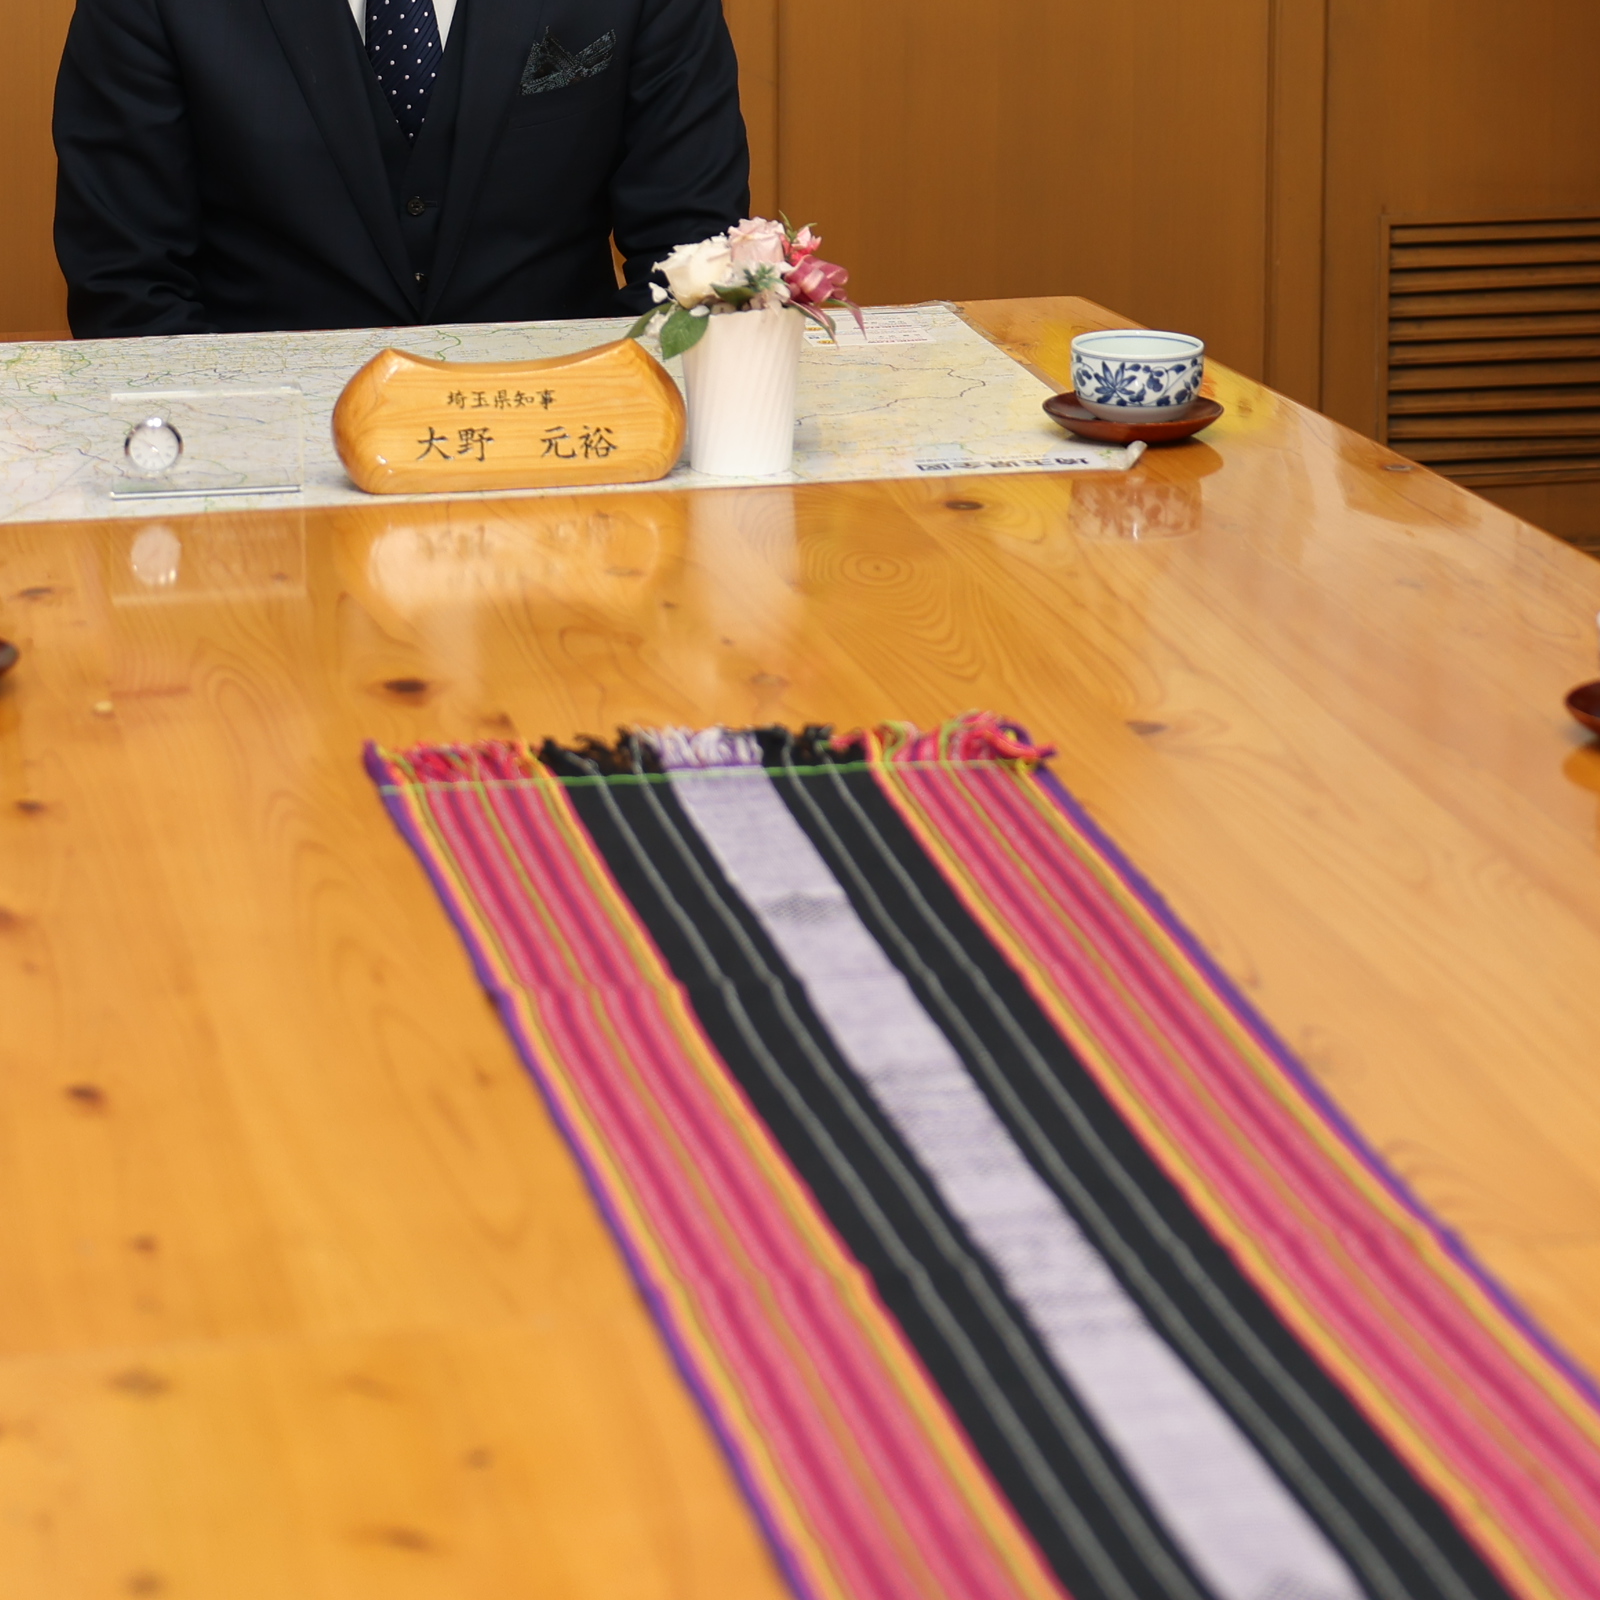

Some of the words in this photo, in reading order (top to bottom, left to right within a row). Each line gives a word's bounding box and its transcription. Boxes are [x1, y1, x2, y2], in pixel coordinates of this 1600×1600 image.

[446, 389, 557, 410] 埼玉県知事
[416, 425, 494, 461] 大野
[540, 425, 617, 459] 元裕
